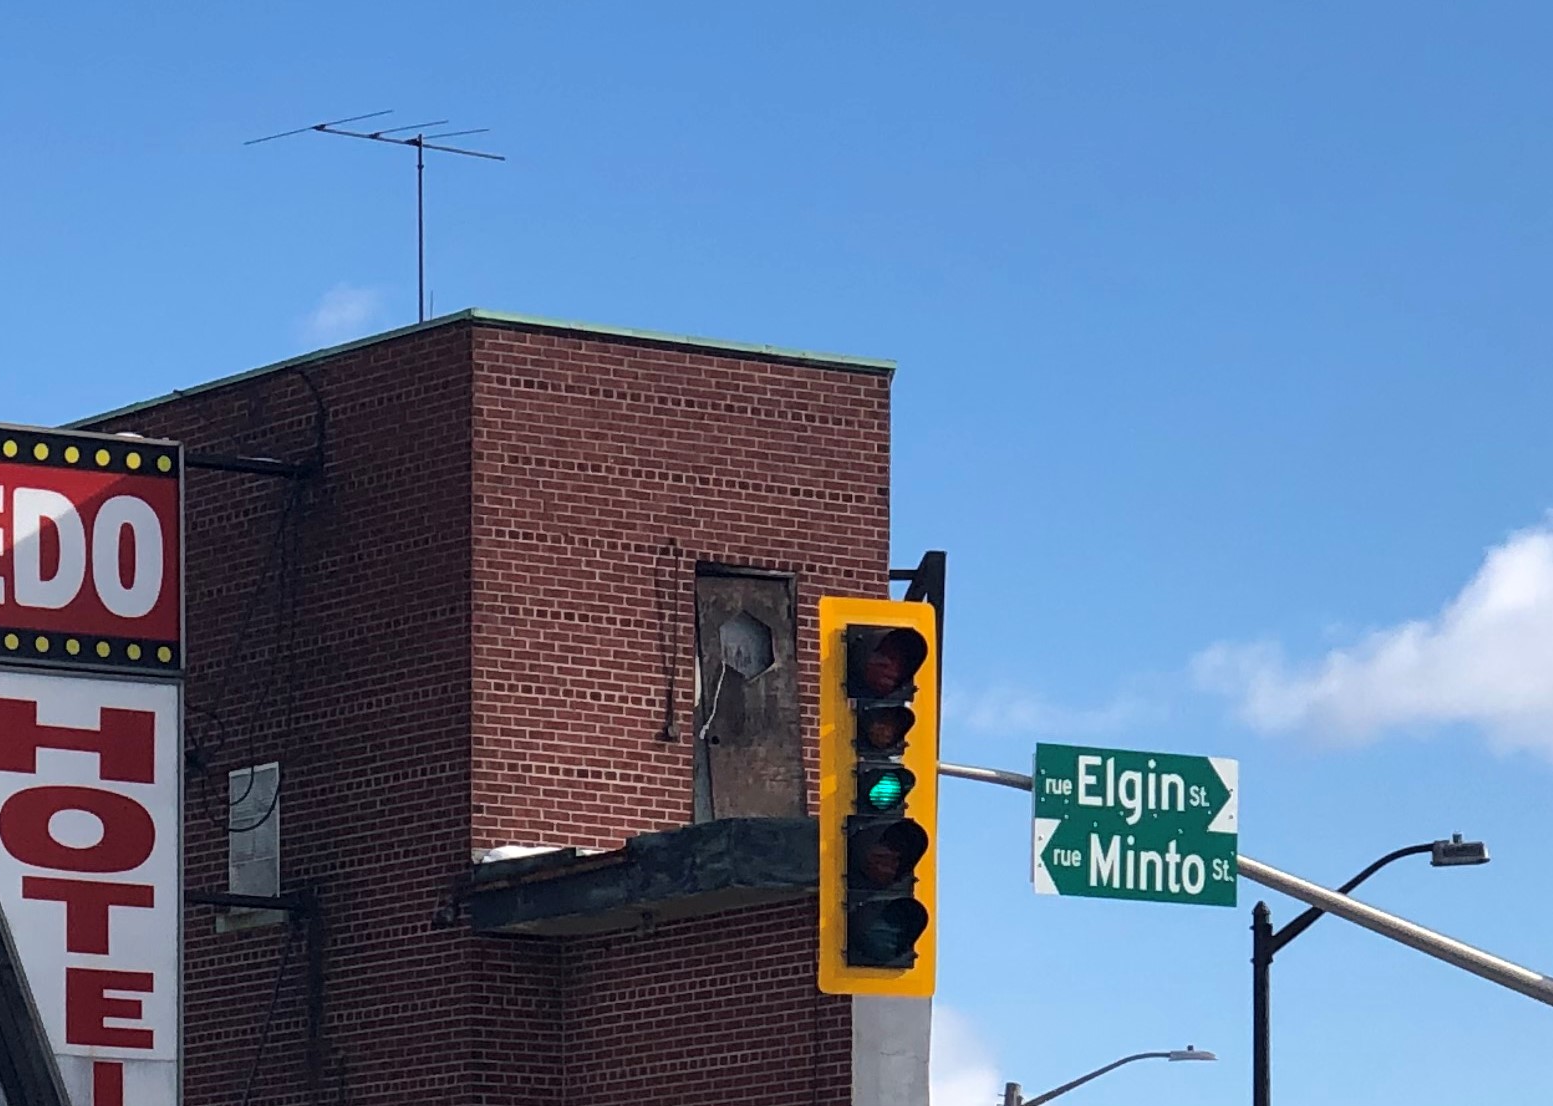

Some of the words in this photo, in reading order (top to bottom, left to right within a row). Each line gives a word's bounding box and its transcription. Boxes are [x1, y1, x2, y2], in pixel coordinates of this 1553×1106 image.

[1046, 777, 1073, 796] rue
[1077, 754, 1186, 826] Elgin
[1189, 785, 1210, 808] St.
[1053, 848, 1082, 867] rue
[1089, 832, 1206, 895] Minto
[1212, 858, 1235, 882] St.
